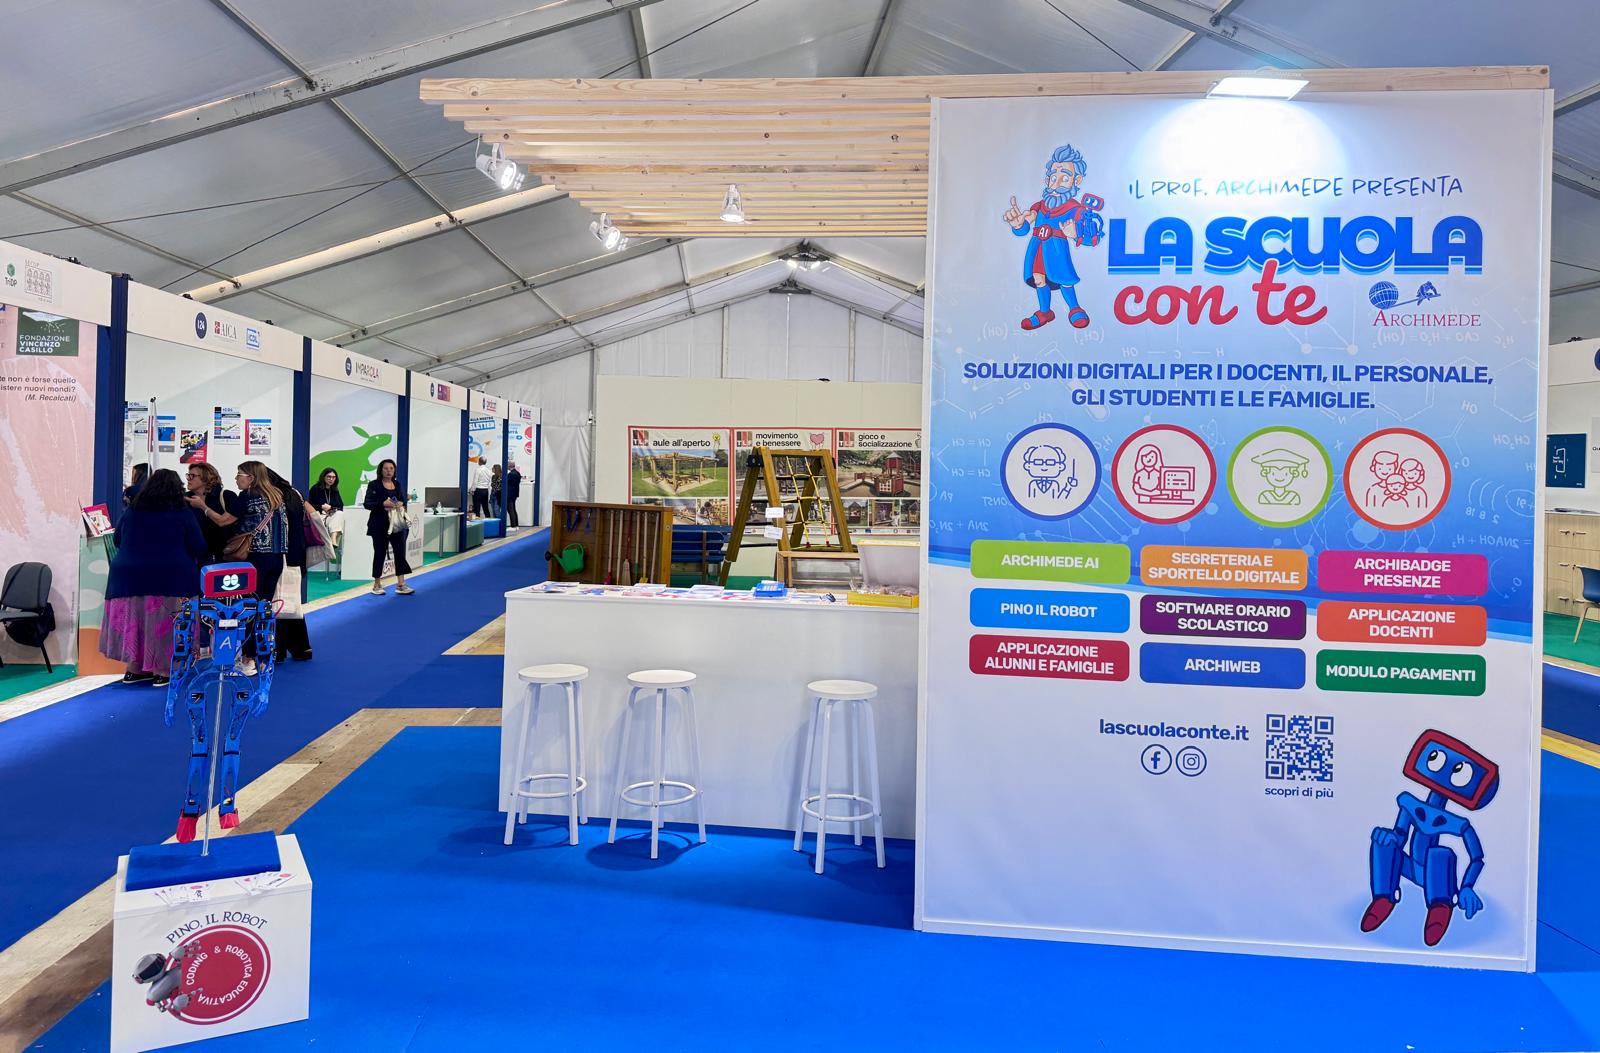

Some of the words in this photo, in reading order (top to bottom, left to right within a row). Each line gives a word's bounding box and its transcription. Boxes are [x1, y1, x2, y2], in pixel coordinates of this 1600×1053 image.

[1129, 184, 1144, 198] IL
[1152, 181, 1207, 196] PROF.
[1216, 177, 1343, 197] ARCHIMEDE
[1353, 175, 1463, 197] PRESENTA
[1108, 217, 1193, 274] LA
[1204, 216, 1482, 274] SCUOLA
[1113, 284, 1238, 325] con
[1252, 259, 1328, 325] te
[1372, 310, 1482, 327] ARCHIMEDE
[221, 323, 237, 339] AICA
[52, 376, 76, 384] quello
[964, 362, 1073, 379] SOLUZIONI
[1077, 363, 1165, 380] DIGITALI
[1170, 363, 1213, 380] PER
[1217, 364, 1222, 380] I
[1227, 364, 1328, 383] DOCENTI,
[1333, 364, 1351, 381] IL
[1355, 365, 1493, 385] PERSONALE,
[39, 394, 77, 402] Recalcati)
[1072, 389, 1104, 406] GLI
[1108, 389, 1216, 407] STUDENTI
[1221, 390, 1234, 406] E
[1238, 390, 1264, 407] LE
[1269, 391, 1375, 409] FAMIGLIE.
[652, 438, 670, 447] aule
[671, 438, 711, 448] all'aperto
[763, 438, 801, 447] benessere
[858, 433, 878, 442] gioco
[858, 439, 912, 447] socializzazione
[1001, 554, 1083, 568] ARCHIMEDE
[1084, 557, 1099, 569] AI
[1171, 552, 1262, 566] SEGRETERIA
[1264, 556, 1273, 567] E
[1354, 558, 1451, 572] ARCHIBADGE
[1149, 567, 1232, 581] SPORTELLO
[1235, 571, 1299, 584] DIGITALE
[1364, 574, 1441, 588] PRESENZE
[1000, 603, 1033, 615] PINO
[1035, 604, 1048, 616] IL
[1050, 605, 1097, 617] ROBOT
[1156, 601, 1234, 615] SOFTWARE
[1236, 604, 1291, 617] ORARIO
[1348, 608, 1455, 623] APPLICAZIONE
[1178, 618, 1268, 632] SCOLASTICO
[1369, 625, 1433, 638] DOCENTI
[997, 642, 1098, 657] APPLICAZIONE
[985, 657, 1036, 670] ALUNNI
[1039, 659, 1047, 671] E
[1050, 660, 1114, 674] FAMIGLIE
[1184, 658, 1261, 673] ARCHIWEB
[1326, 665, 1388, 678] MODULO
[1391, 667, 1476, 681] PAGAMENTI
[1099, 719, 1249, 741] lascuolaconte.it
[1264, 787, 1299, 798] scopri
[1302, 786, 1313, 797] di
[1315, 787, 1334, 799] più
[166, 920, 203, 943] PINO,
[205, 914, 219, 925] IL
[223, 911, 267, 929] ROBOT
[214, 945, 221, 954] &
[186, 952, 208, 985] CODING
[225, 944, 253, 979] ROBOTICA
[197, 980, 248, 1005] EDUCATIVA
